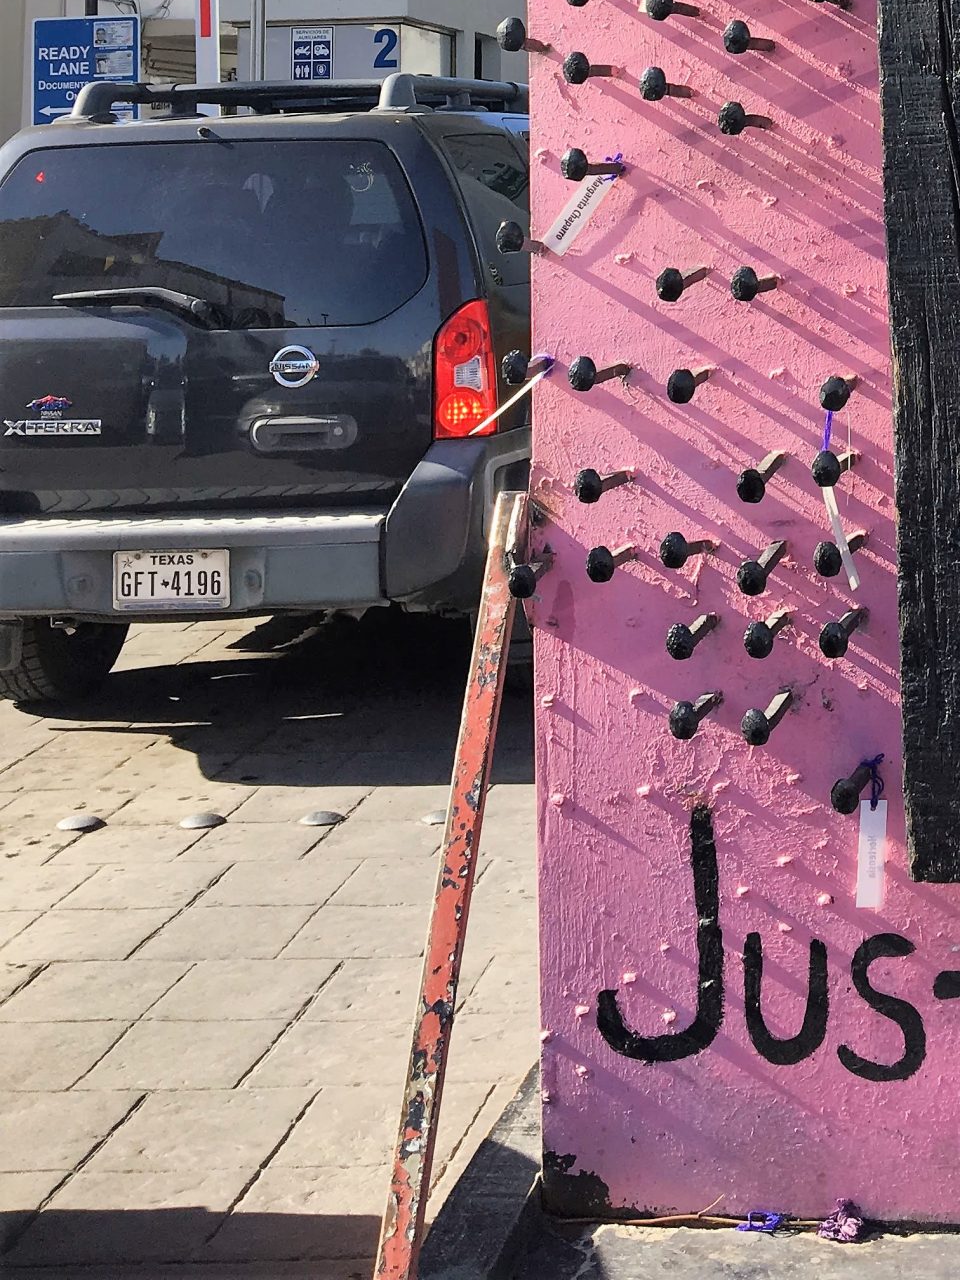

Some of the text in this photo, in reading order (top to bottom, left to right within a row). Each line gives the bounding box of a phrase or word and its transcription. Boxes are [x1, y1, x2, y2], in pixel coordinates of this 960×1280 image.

[38, 46, 90, 60] READY
[374, 28, 398, 68] 2
[50, 62, 90, 76] LANE
[556, 209, 582, 241] Chaparro
[150, 554, 194, 566] TEXAS
[121, 570, 221, 596] GFT 4196
